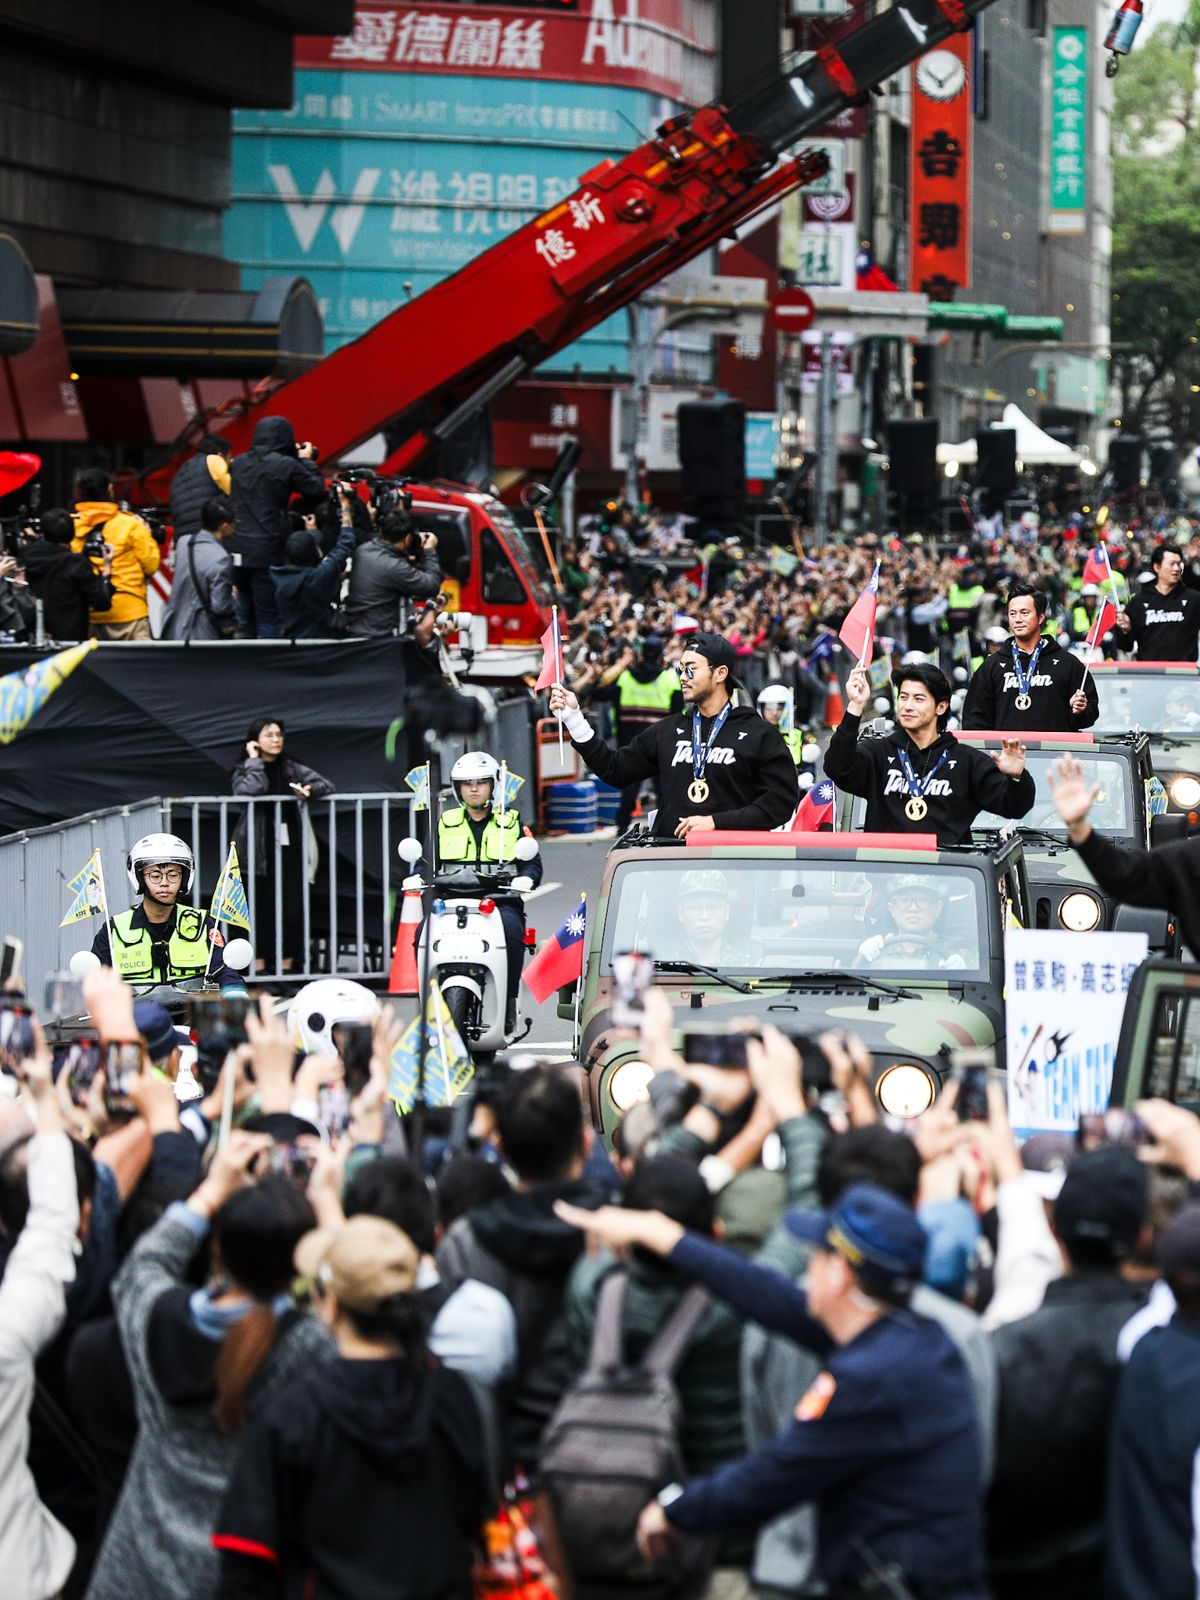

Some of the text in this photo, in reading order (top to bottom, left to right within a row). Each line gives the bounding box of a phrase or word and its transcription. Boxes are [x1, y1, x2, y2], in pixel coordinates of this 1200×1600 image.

[331, 11, 545, 70] 愛德蘭絲
[883, 769, 953, 797] Taian
[120, 960, 146, 970] POLICE
